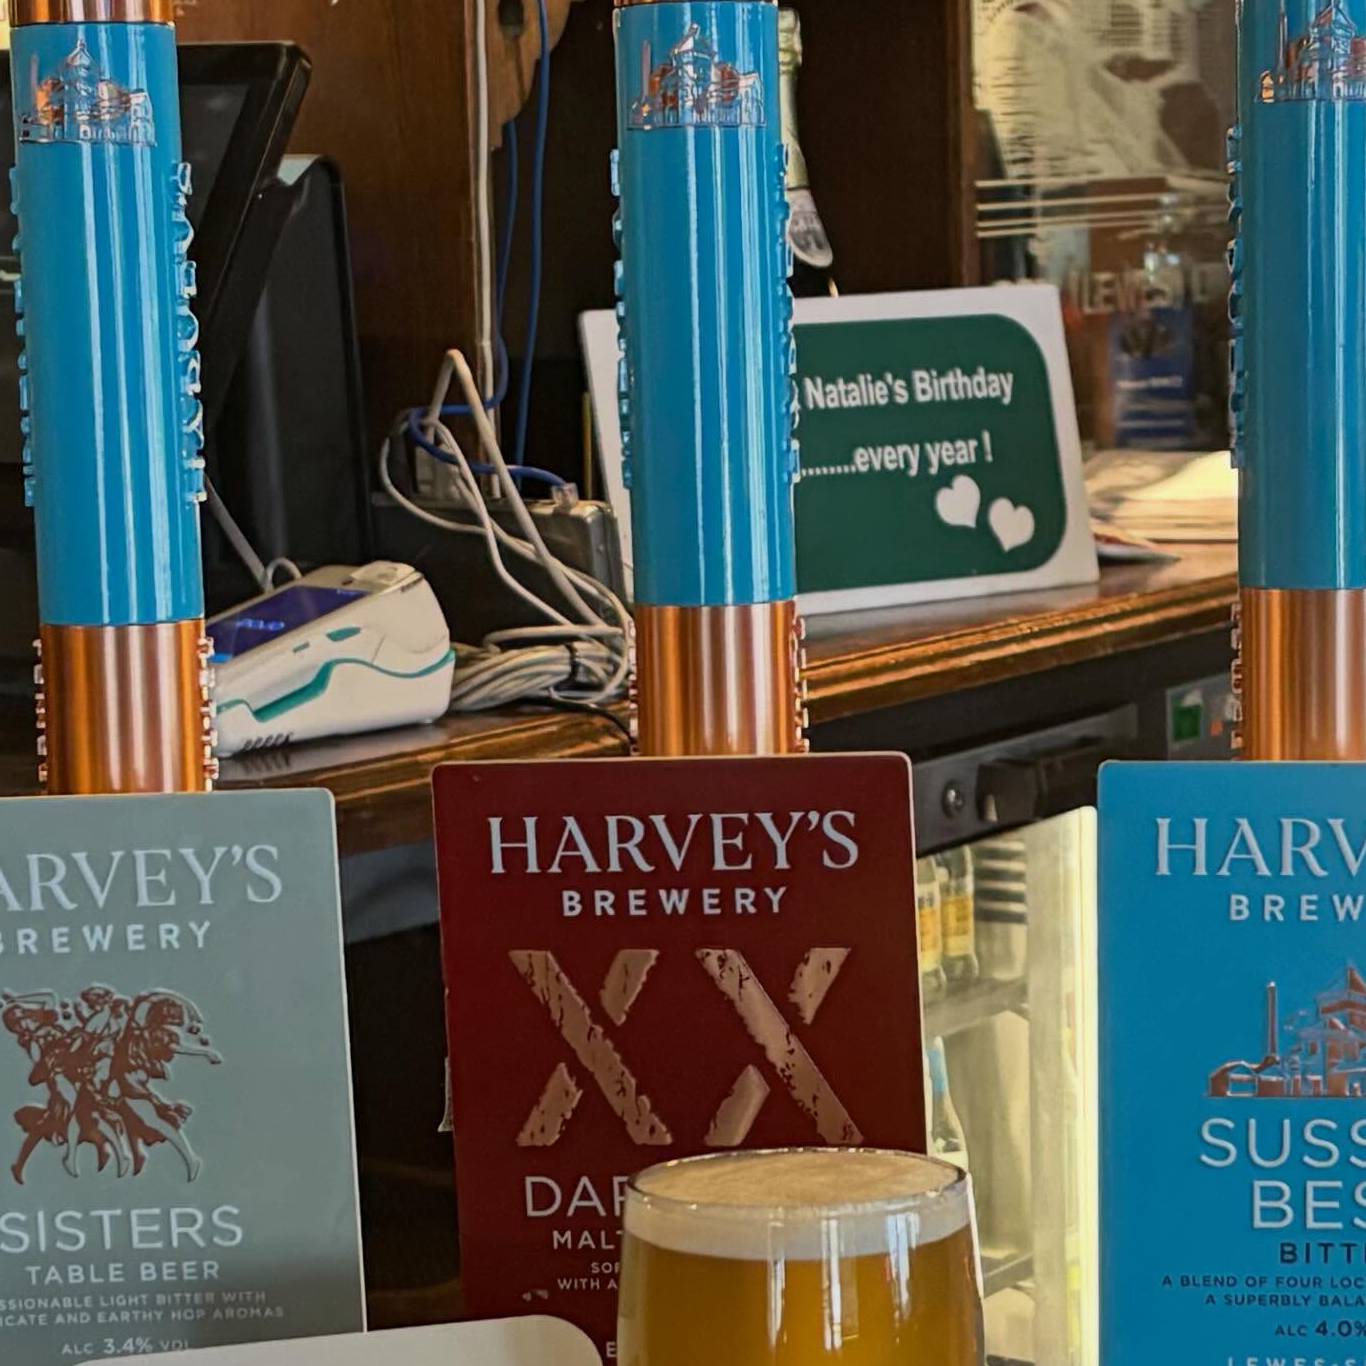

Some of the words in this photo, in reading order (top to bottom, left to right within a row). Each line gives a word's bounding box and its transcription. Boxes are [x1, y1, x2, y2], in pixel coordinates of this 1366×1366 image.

[805, 375, 910, 409] Natalie's
[912, 368, 1014, 405] Birthday
[925, 438, 978, 475] year
[488, 810, 860, 874] HARVEY'S
[562, 886, 788, 917] BREWERY
[25, 1264, 126, 1286] TABLE
[139, 1261, 222, 1283] BEER
[1161, 1275, 1173, 1287] A
[1179, 1275, 1237, 1289] BLEND
[1244, 1275, 1268, 1289] OF
[1275, 1275, 1323, 1290] FOUR
[557, 1278, 601, 1291] WITH
[99, 1294, 149, 1308] LIGHT
[155, 1292, 215, 1307] BITTER
[220, 1290, 268, 1305] WITH
[1204, 1294, 1217, 1306] A
[1223, 1293, 1311, 1308] SUPERBLY
[54, 1312, 91, 1325] AND
[97, 1309, 163, 1324] EARTHY
[171, 1308, 206, 1322] HOP
[212, 1306, 285, 1321] AROMAS
[1274, 1323, 1307, 1337] ALC
[61, 1342, 94, 1356] ALC
[102, 1337, 154, 1356] 3.4%
